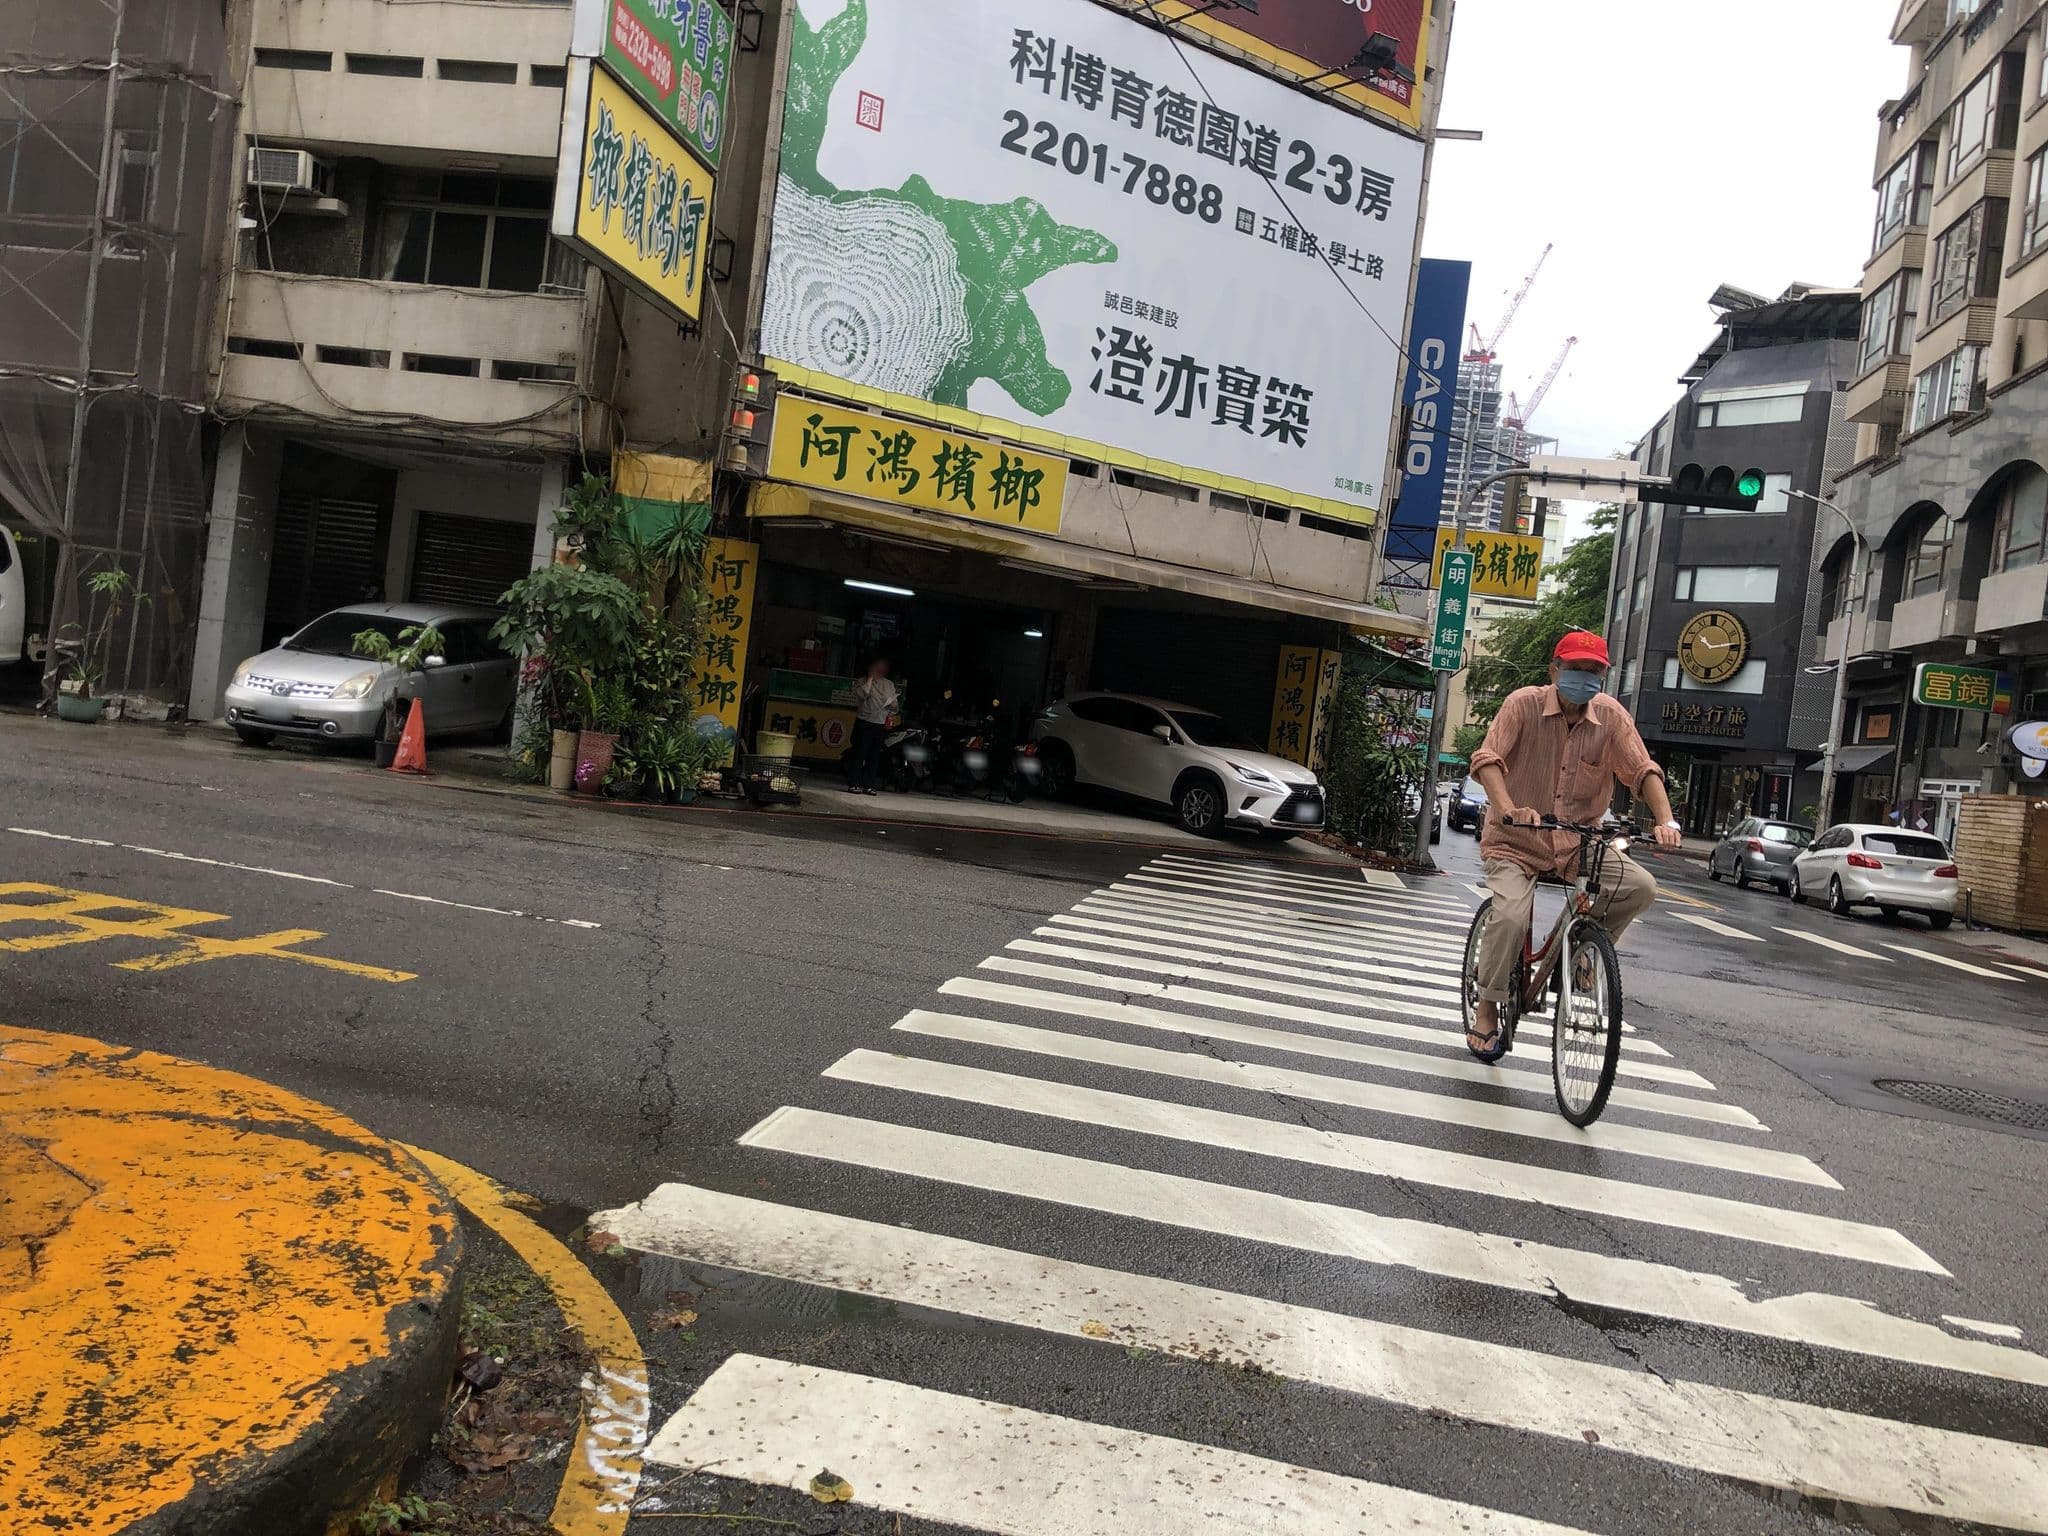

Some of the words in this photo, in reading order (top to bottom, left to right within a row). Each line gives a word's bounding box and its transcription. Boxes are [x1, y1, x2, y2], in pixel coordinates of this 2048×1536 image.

[1000, 110, 1223, 225] 2201-7888
[1089, 326, 1314, 448] 澄亦實築
[1406, 338, 1446, 476] CASIO
[800, 413, 1045, 522] 阿鴻檳榔
[698, 553, 750, 713] 阿鴻檳榔
[1440, 567, 1466, 645] 明義街
[1662, 702, 1746, 725] 時空行旅
[1925, 671, 1991, 705] 富鏡
